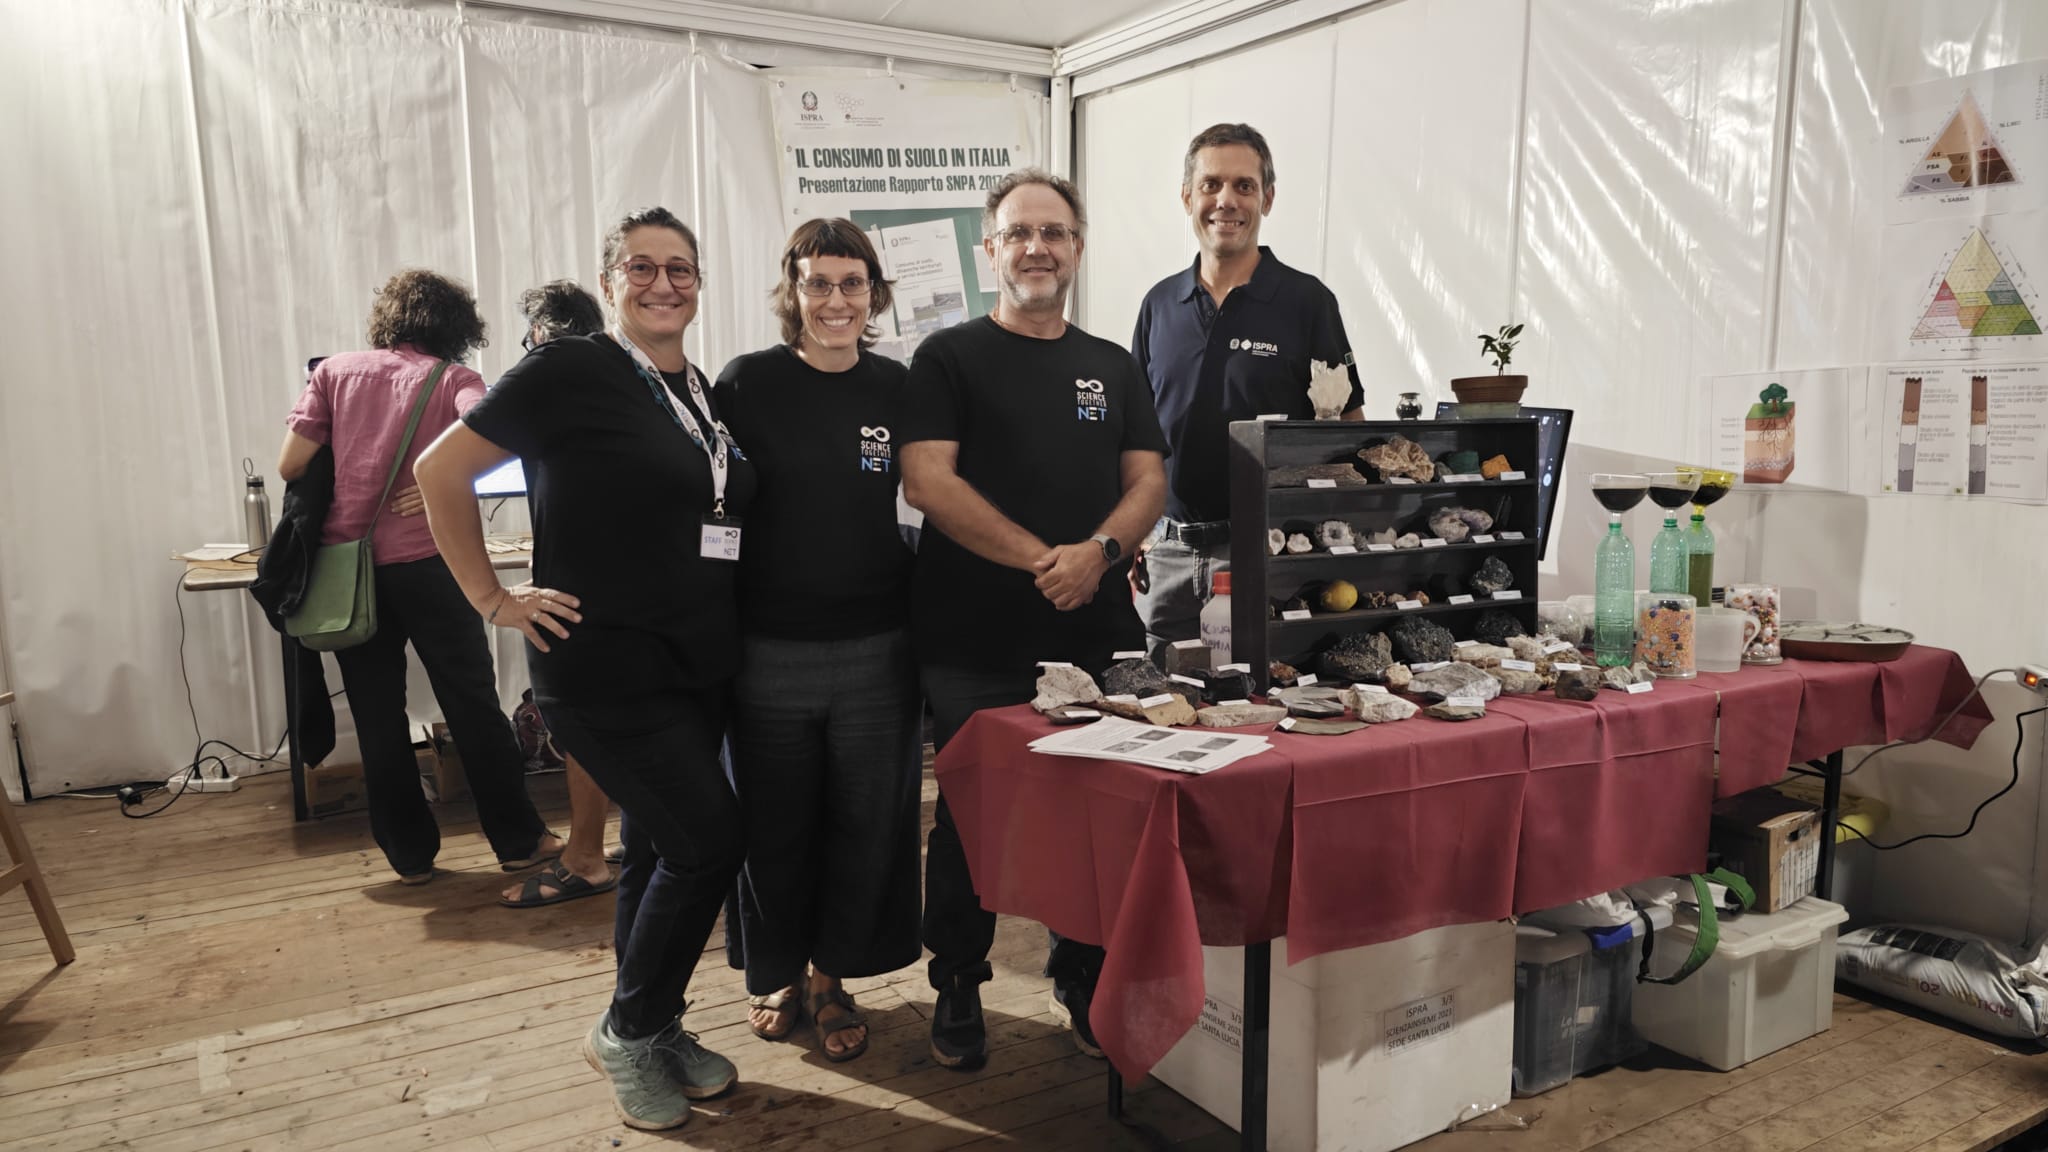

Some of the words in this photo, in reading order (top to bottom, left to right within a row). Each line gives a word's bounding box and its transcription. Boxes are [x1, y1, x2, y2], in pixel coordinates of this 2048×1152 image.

[795, 148, 809, 168] IL
[813, 148, 883, 168] CONSUMO
[888, 148, 901, 168] DI
[905, 148, 948, 168] SUOLO
[951, 148, 965, 167] IN
[969, 148, 1011, 167] ITALIA
[799, 176, 886, 194] Presentazione
[889, 176, 943, 195] Rapporto
[946, 175, 976, 191] SNPA
[1252, 341, 1278, 352] ISPRA
[1077, 391, 1105, 401] SCIENCE
[1077, 406, 1107, 421] NET
[860, 440, 890, 450] SCIENCE
[861, 456, 891, 472] NET
[1406, 1003, 1428, 1019] ISPRA
[1388, 1037, 1406, 1050] SEDE
[1407, 1029, 1430, 1044] SANTA
[1431, 1021, 1451, 1036] LUCIA
